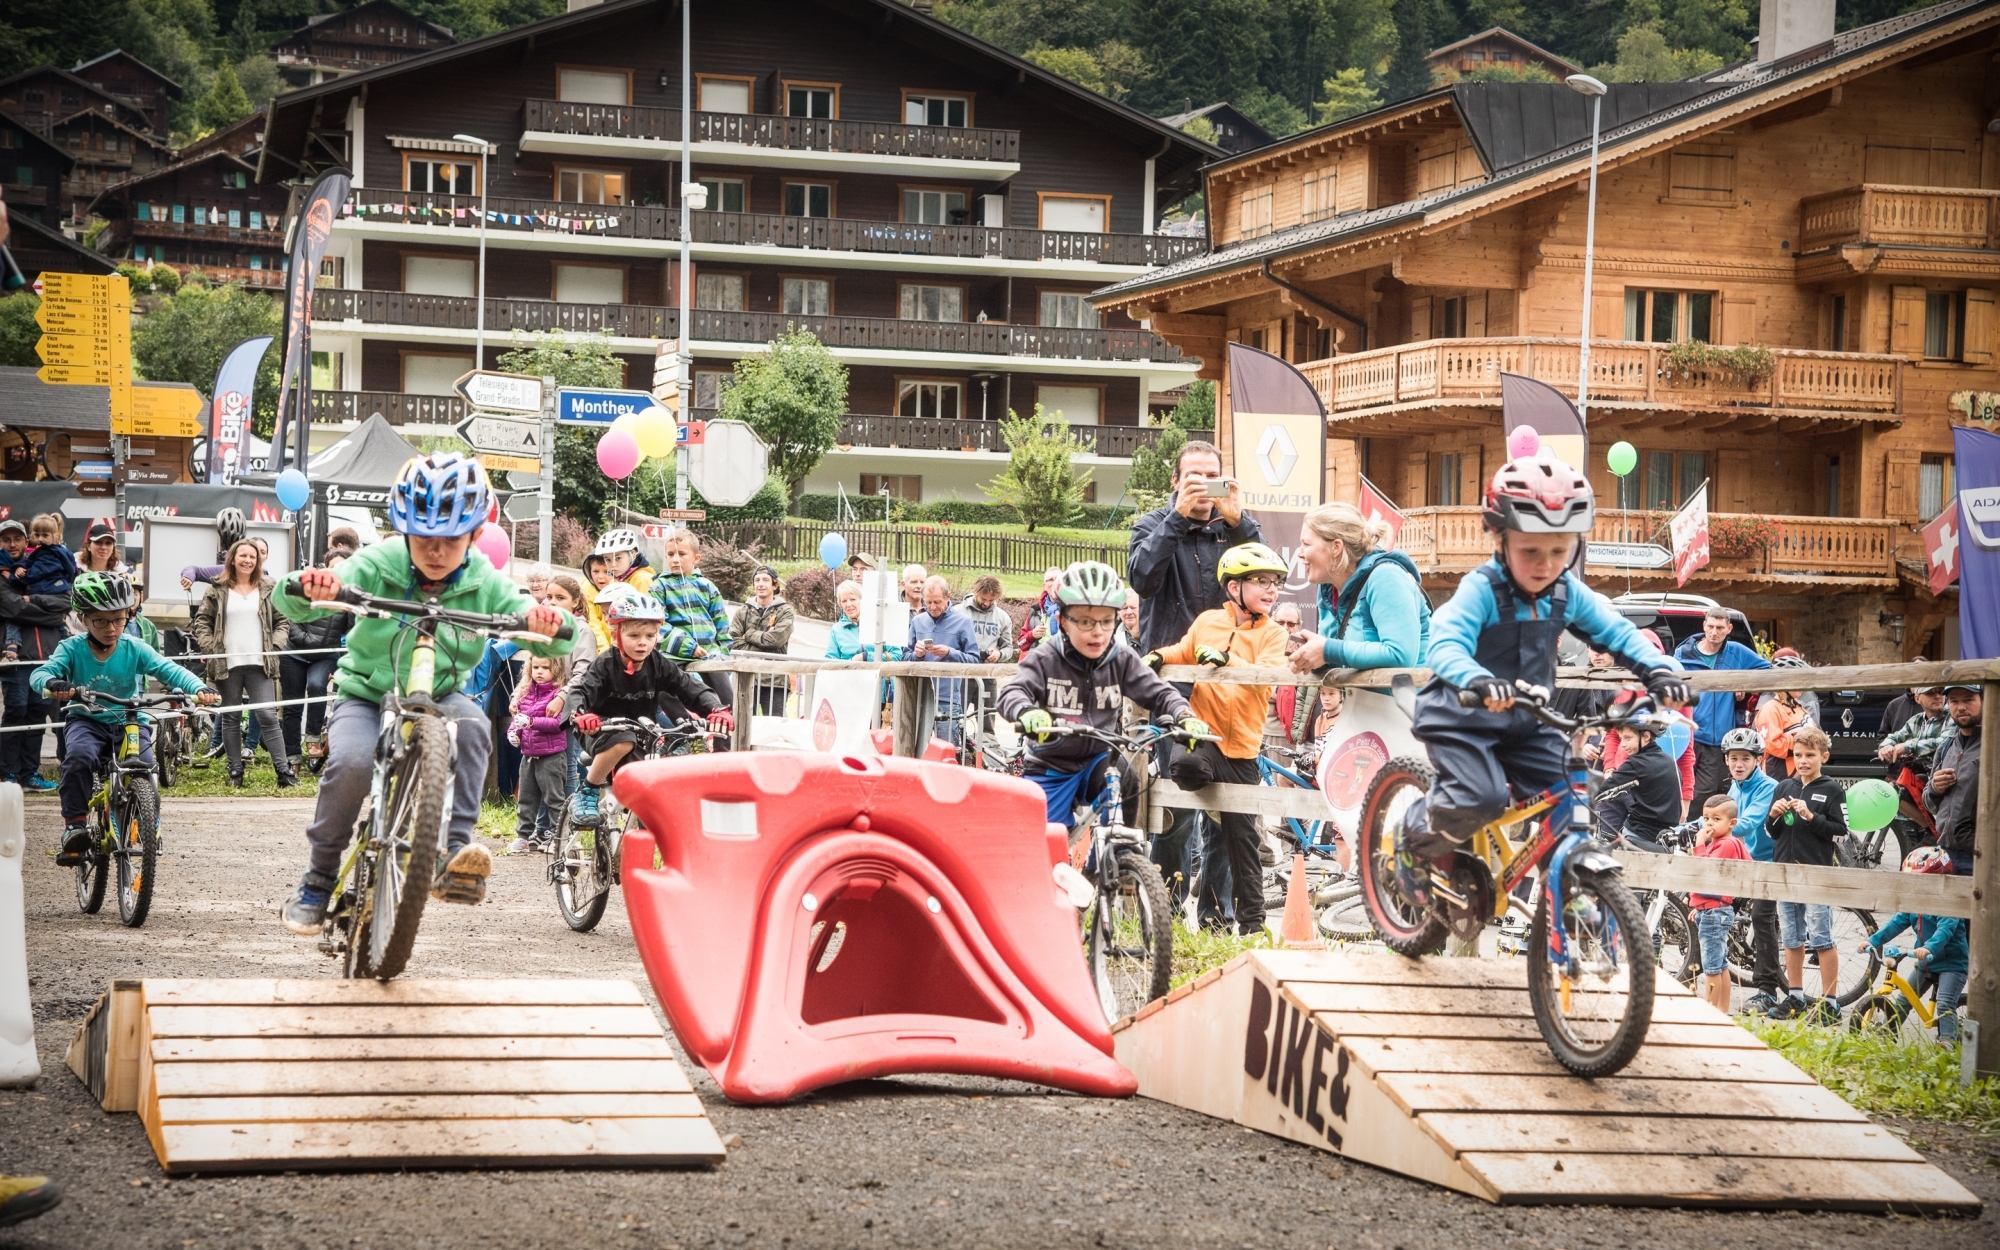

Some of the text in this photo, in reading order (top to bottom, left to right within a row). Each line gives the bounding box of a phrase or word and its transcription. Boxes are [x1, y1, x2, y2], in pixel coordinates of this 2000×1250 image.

[571, 397, 635, 415] Monthey
[220, 391, 244, 444] Bike
[478, 421, 518, 434] Les Rives
[492, 436, 519, 448] Paradis
[486, 457, 518, 469] Grd Paradis
[341, 490, 392, 502] SCOT
[973, 620, 998, 637] ANS
[1503, 825, 1548, 885] SCOTT
